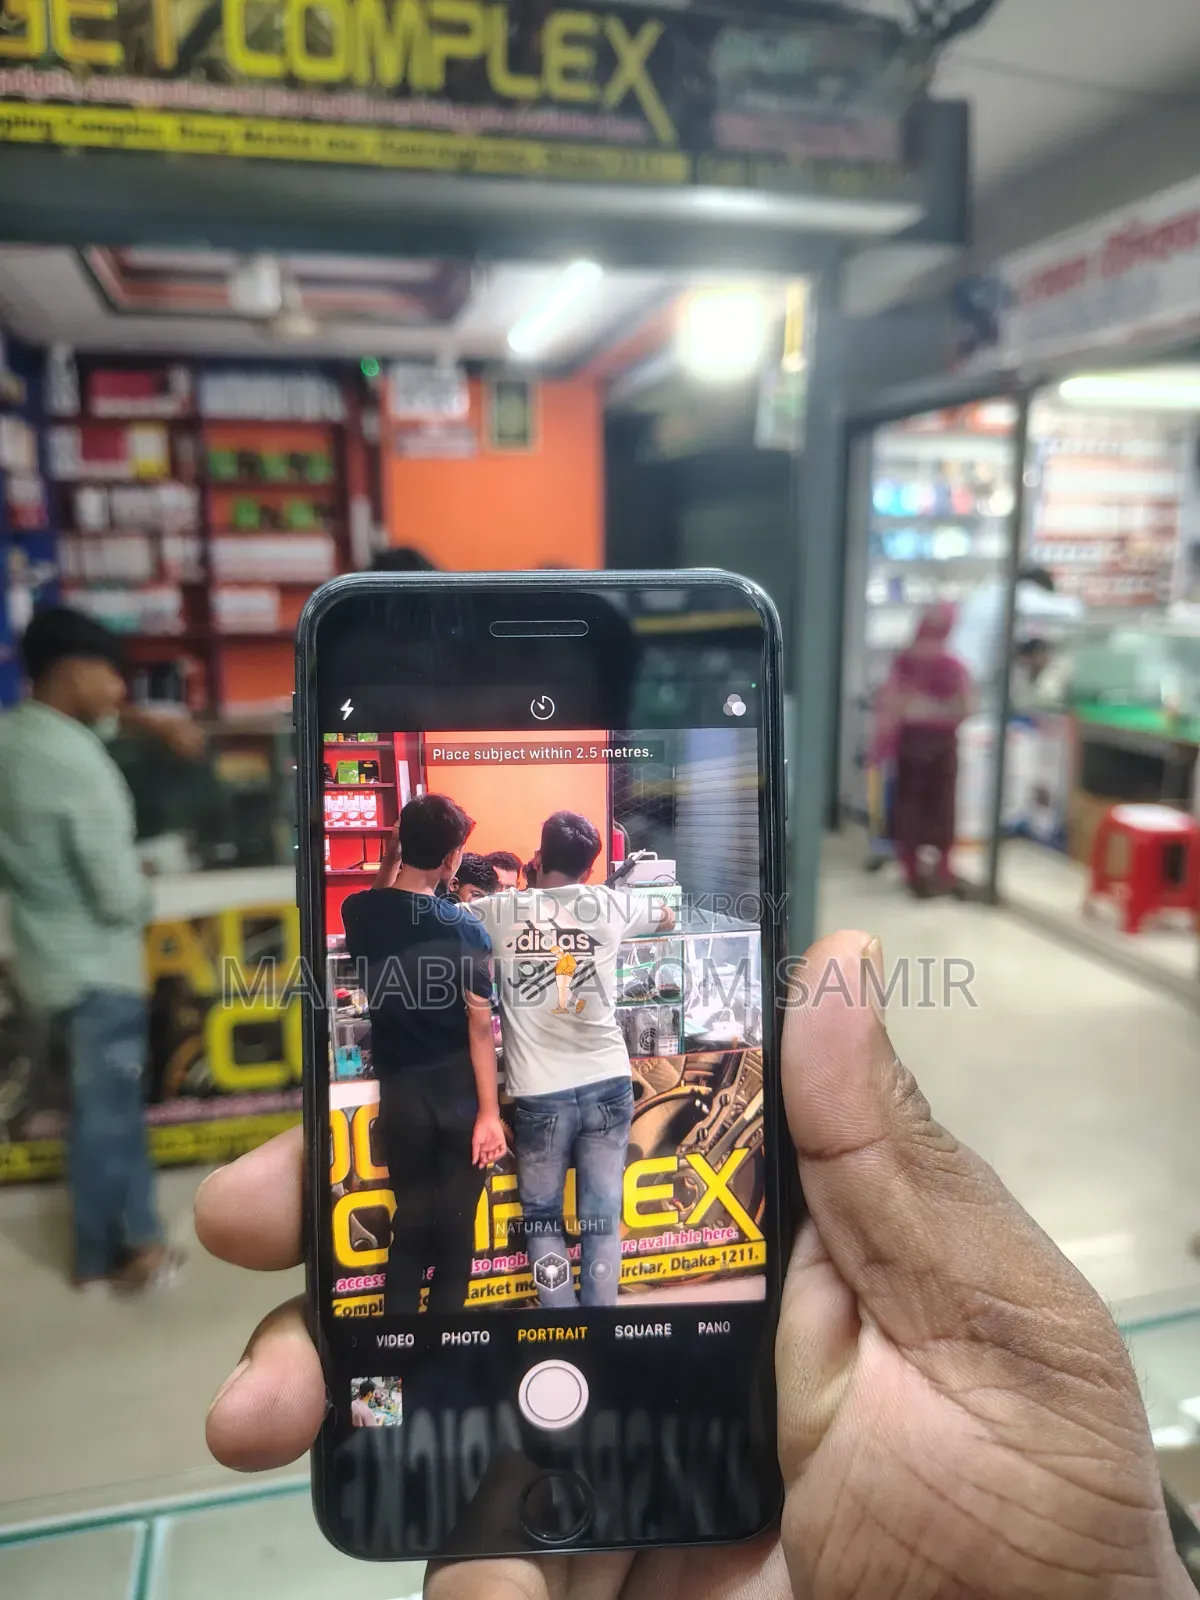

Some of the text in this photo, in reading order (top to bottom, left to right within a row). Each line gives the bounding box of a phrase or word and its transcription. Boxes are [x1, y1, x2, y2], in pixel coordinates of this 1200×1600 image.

[223, 0, 678, 144] COMPLEX
[432, 746, 655, 763] Place subject within 2.5 metres.
[495, 1218, 607, 1236] NATURAL LIGHT
[336, 1272, 387, 1293] access
[638, 1230, 702, 1251] available
[702, 1226, 739, 1244] here.
[333, 1297, 384, 1316] Compl
[376, 1333, 416, 1348] VIDEO
[441, 1330, 491, 1346] PHOTO
[517, 1326, 589, 1343] PORTRAIT
[614, 1322, 673, 1339] SQUARE
[697, 1320, 731, 1336] PANO
